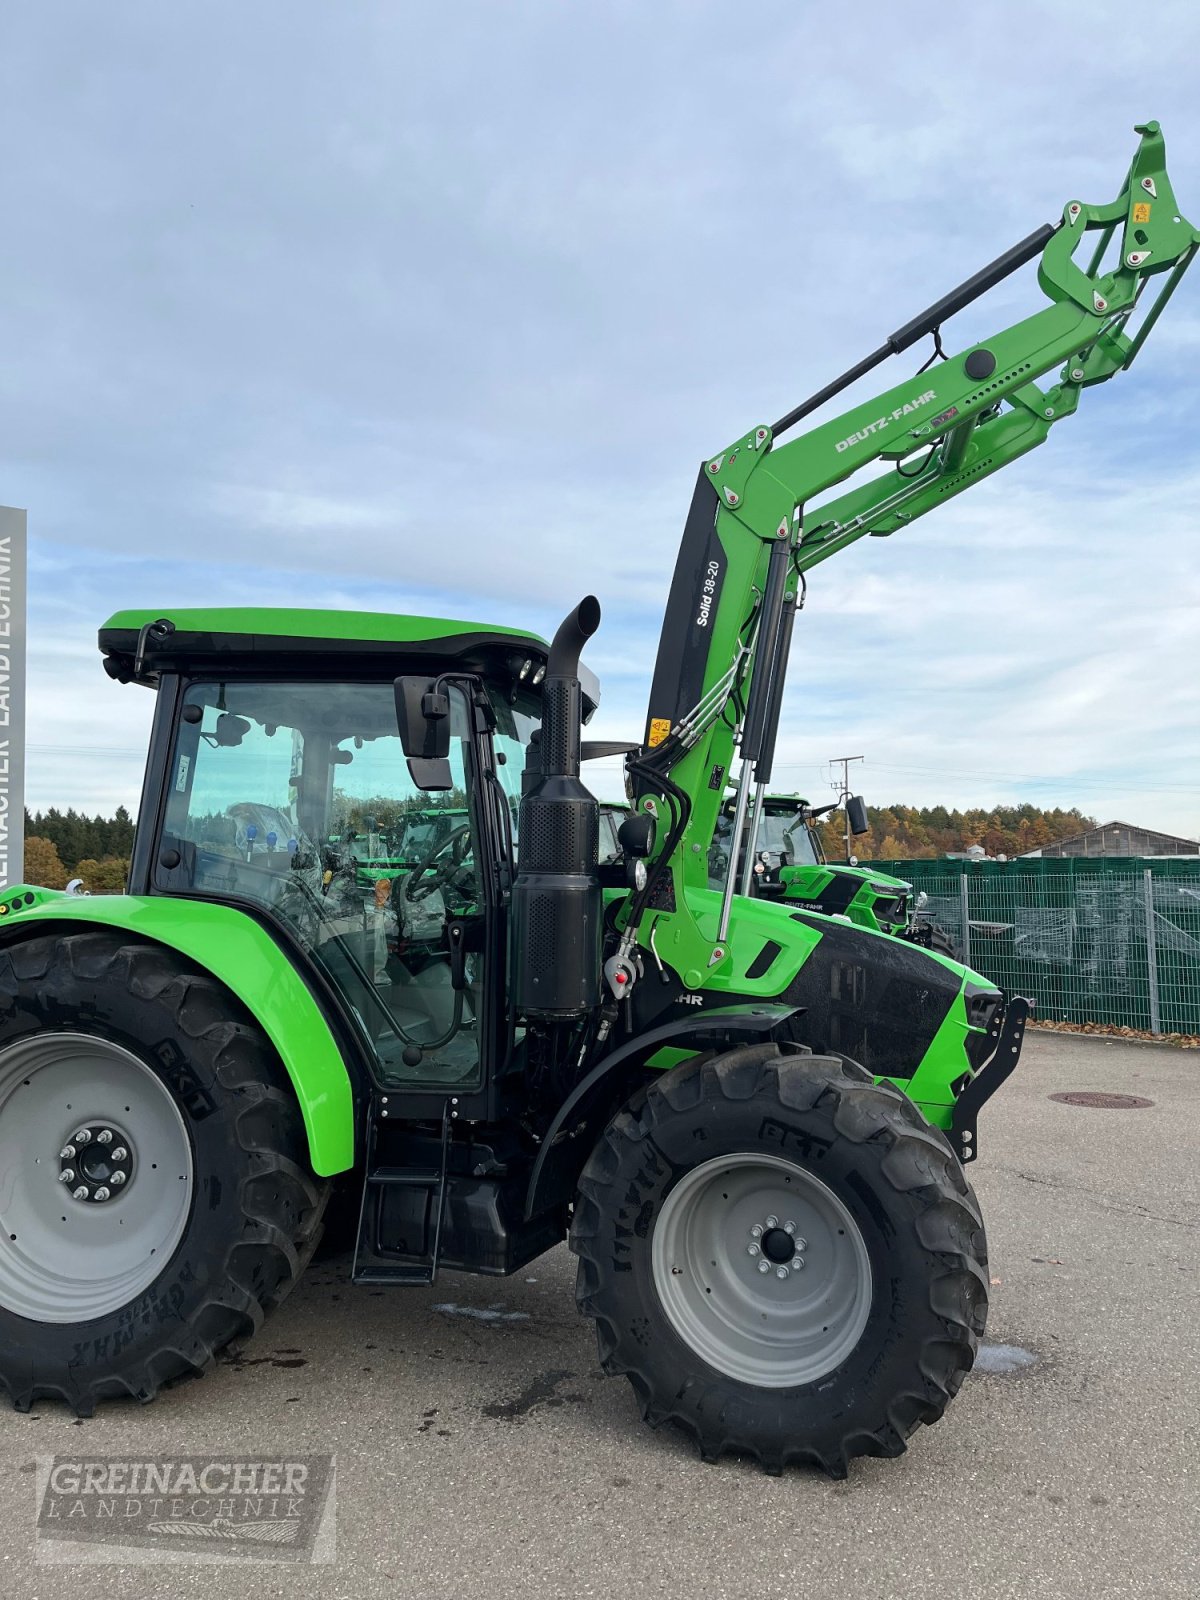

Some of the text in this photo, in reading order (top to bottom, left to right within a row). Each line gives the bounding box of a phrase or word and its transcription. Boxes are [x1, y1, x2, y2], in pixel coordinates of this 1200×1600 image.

[835, 390, 937, 453] DEUTZ-FAHR
[697, 561, 720, 627] Solid 38-20
[157, 1040, 214, 1115] BKT
